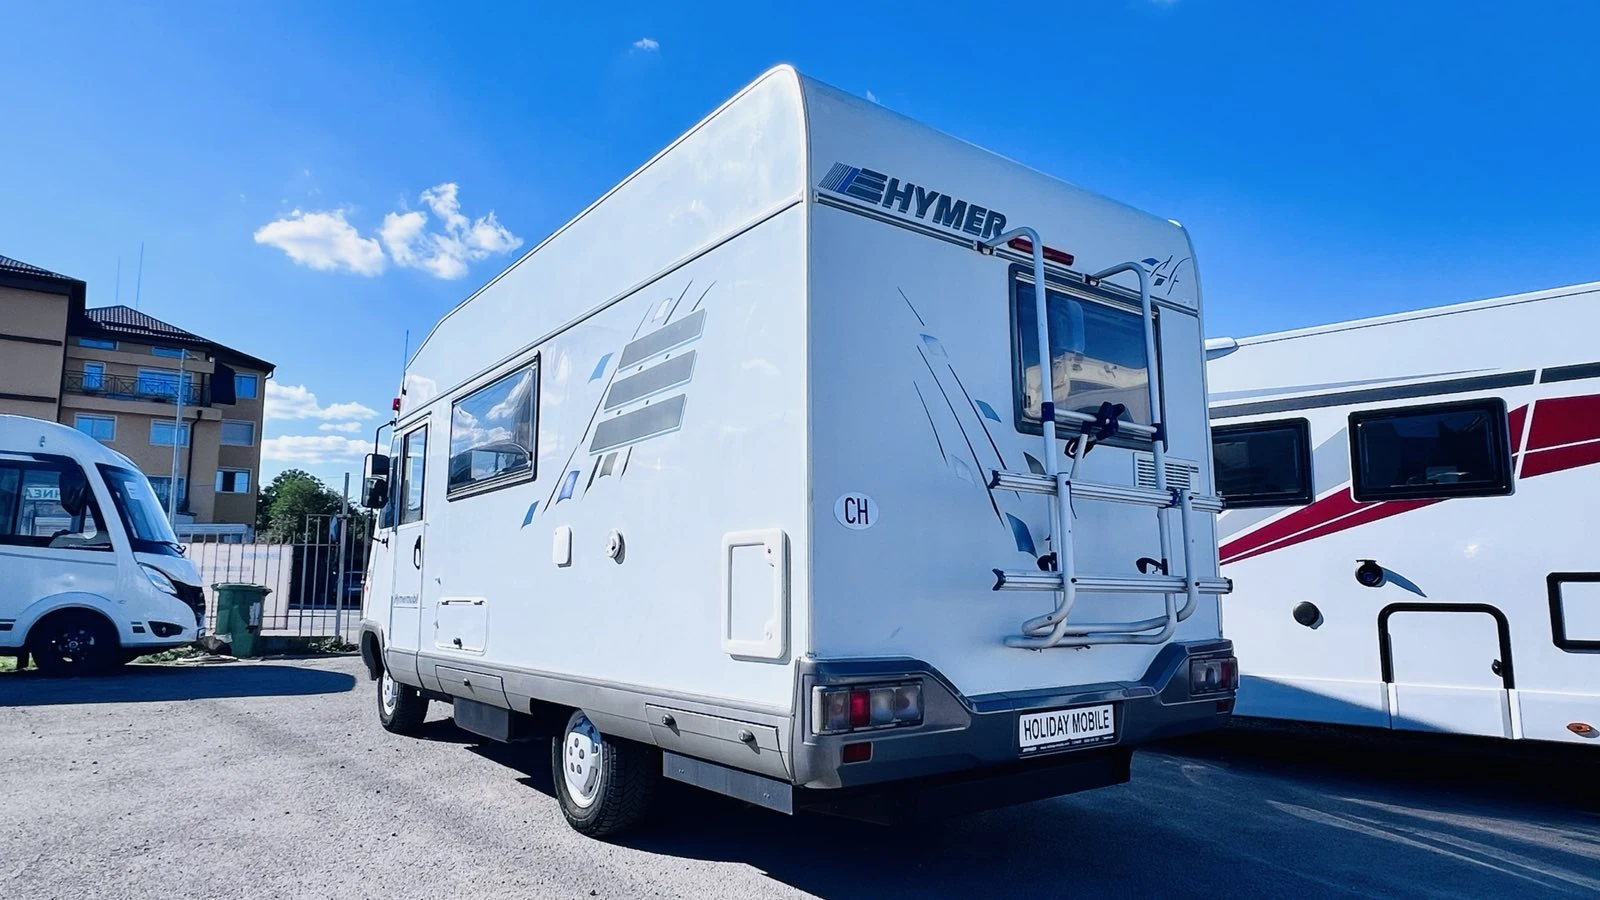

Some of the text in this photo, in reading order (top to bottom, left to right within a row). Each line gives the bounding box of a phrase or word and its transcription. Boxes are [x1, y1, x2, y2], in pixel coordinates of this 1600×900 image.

[882, 177, 1008, 239] HYMER
[844, 496, 869, 525] CH
[1023, 709, 1110, 741] HOLIDAY MOBILE
